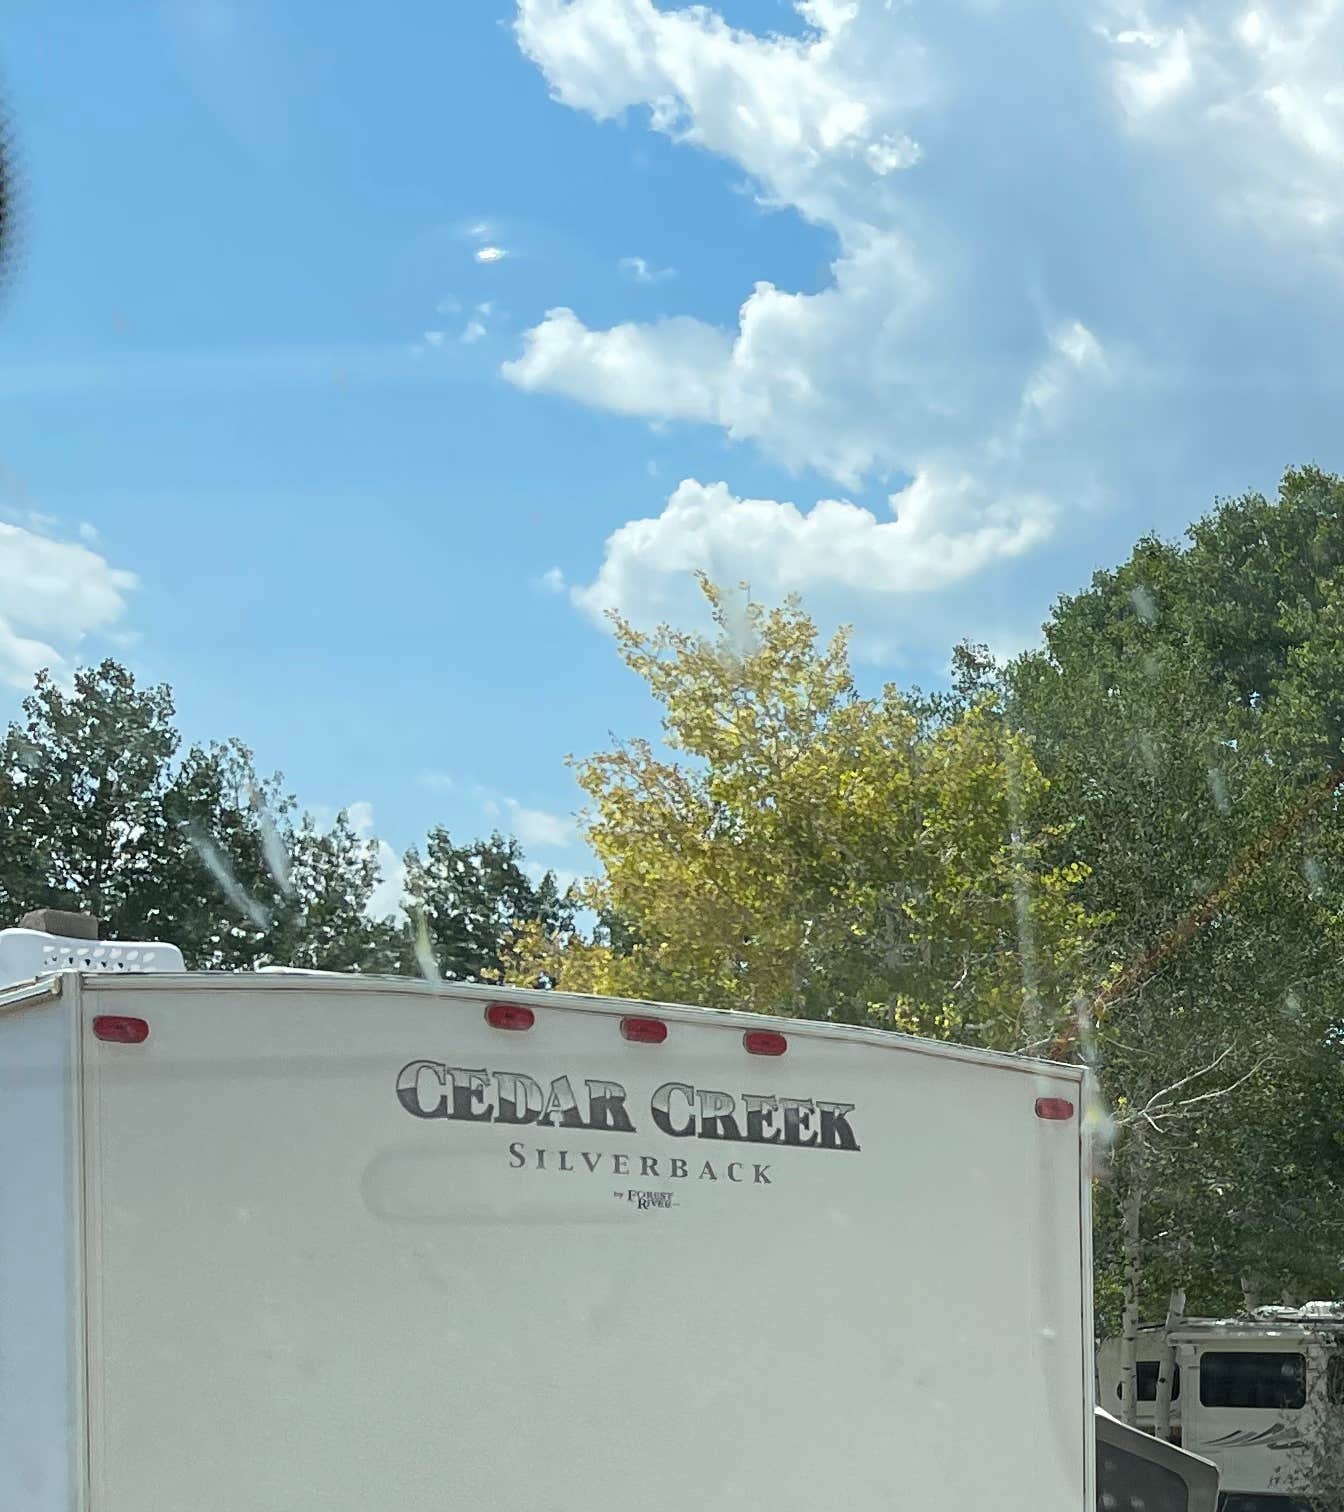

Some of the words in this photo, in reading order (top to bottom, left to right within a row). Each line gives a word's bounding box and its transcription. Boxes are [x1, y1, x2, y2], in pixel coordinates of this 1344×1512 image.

[396, 1059, 637, 1133] CEDAR
[650, 1081, 861, 1152] CREEK
[508, 1141, 774, 1185] SILVERBACK
